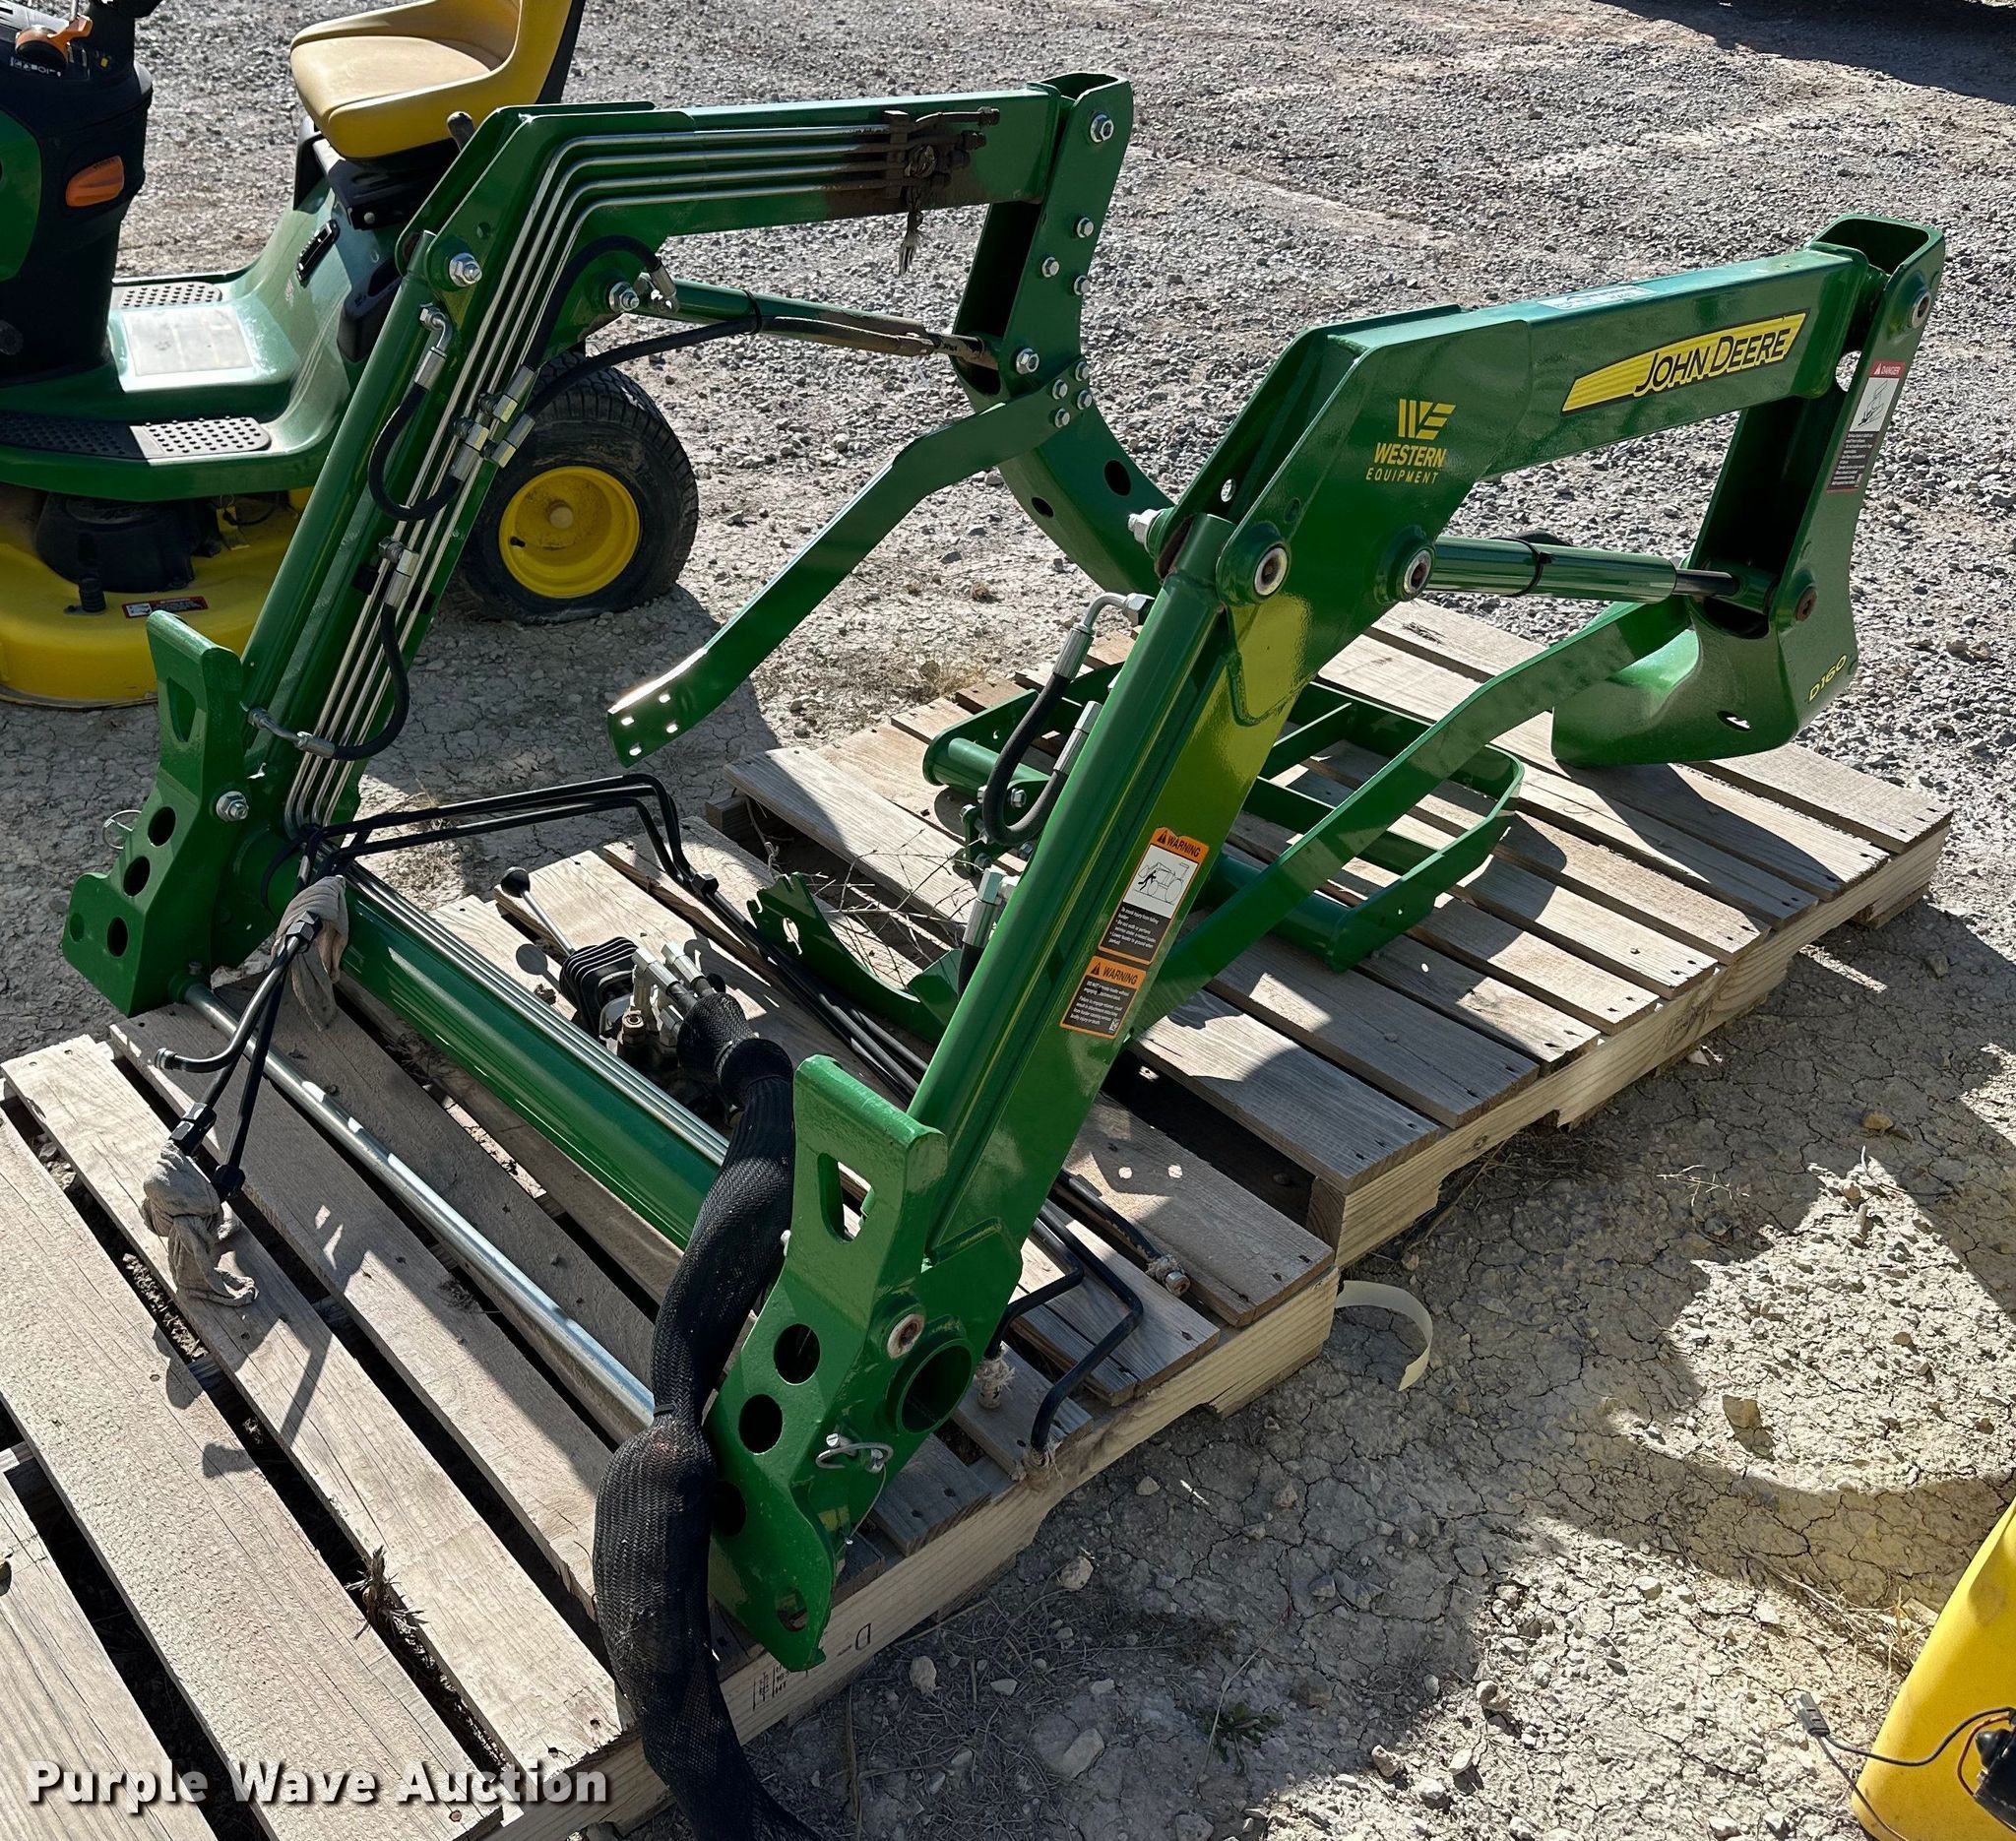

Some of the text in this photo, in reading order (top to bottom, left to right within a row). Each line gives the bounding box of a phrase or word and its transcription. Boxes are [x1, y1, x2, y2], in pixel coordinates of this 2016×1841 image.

[1634, 328, 1791, 396] JOHN DEERE
[1374, 442, 1447, 468] WESTERN
[1365, 468, 1438, 484] EQUIPMENT
[1808, 655, 1847, 702] D160
[1166, 835, 1201, 857] WARNING
[1102, 966, 1139, 984] WARNING
